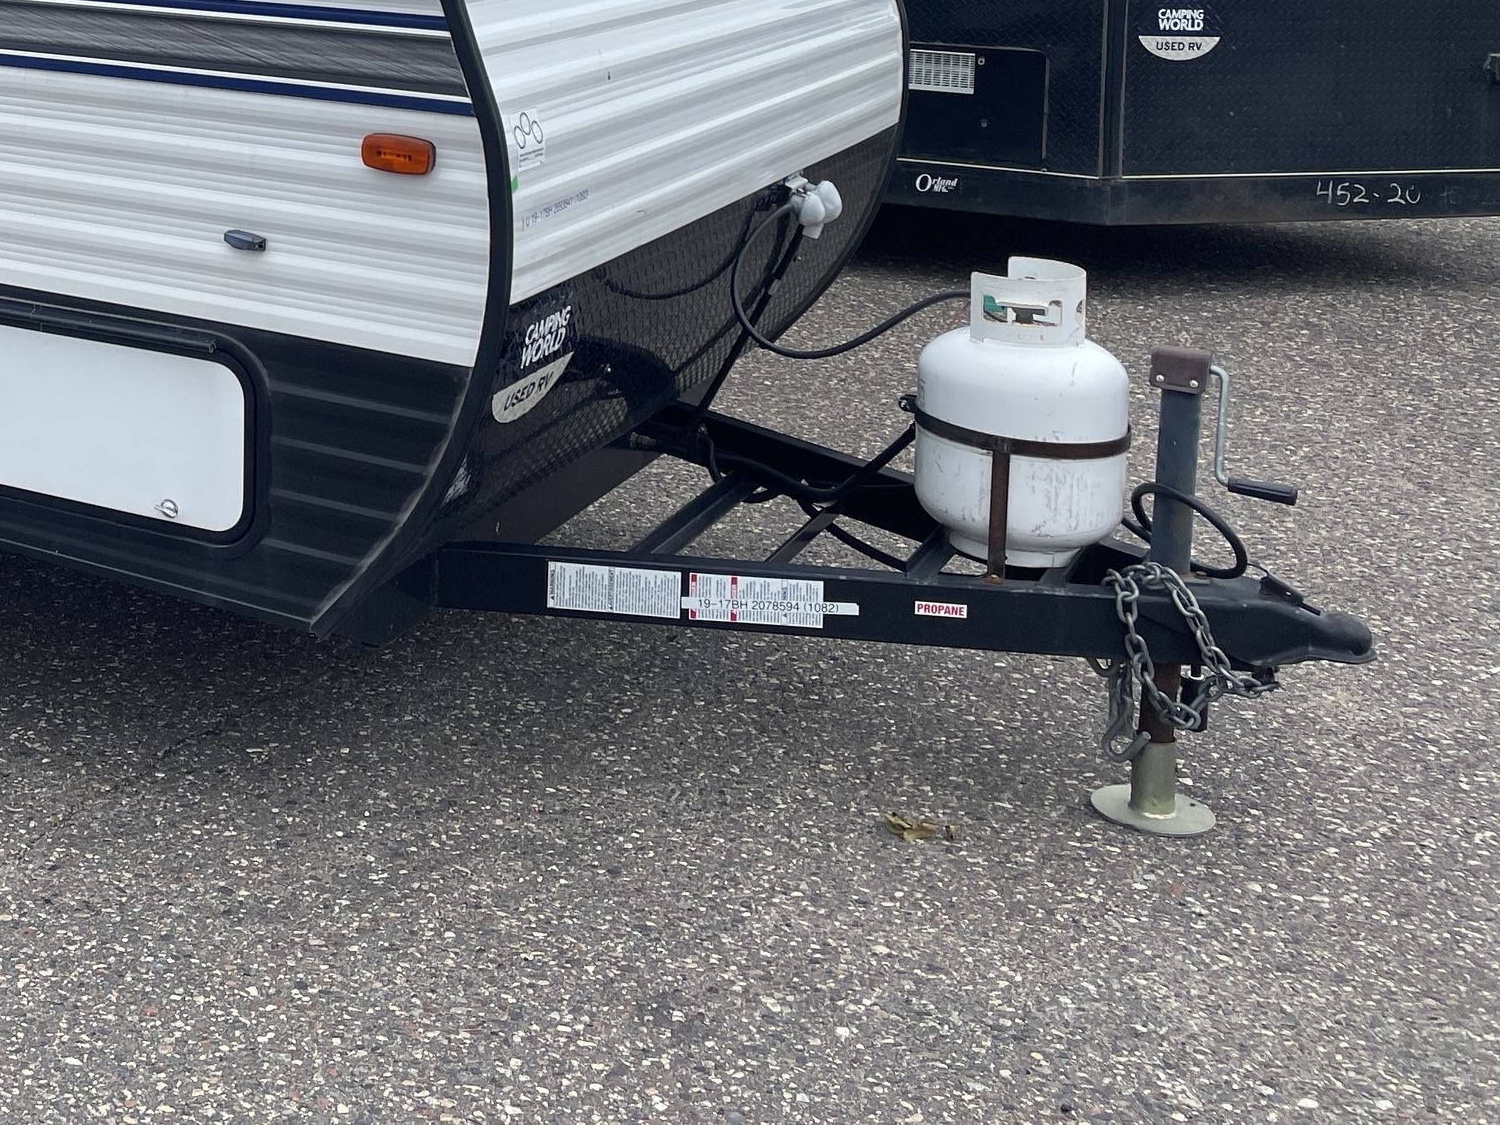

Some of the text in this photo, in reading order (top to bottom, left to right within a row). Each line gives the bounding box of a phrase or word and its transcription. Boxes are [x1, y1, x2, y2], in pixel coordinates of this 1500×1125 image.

[1158, 8, 1204, 20] CAMPING
[1158, 19, 1204, 31] WORLD
[1156, 42, 1203, 51] USED RV
[915, 173, 958, 192] Orland
[525, 305, 572, 345] CAMPING
[520, 327, 566, 369] WORLD
[504, 371, 554, 411] USED RV
[698, 598, 839, 613] 19-17BH 2078594 (1082)
[917, 603, 965, 616] PROPANE
